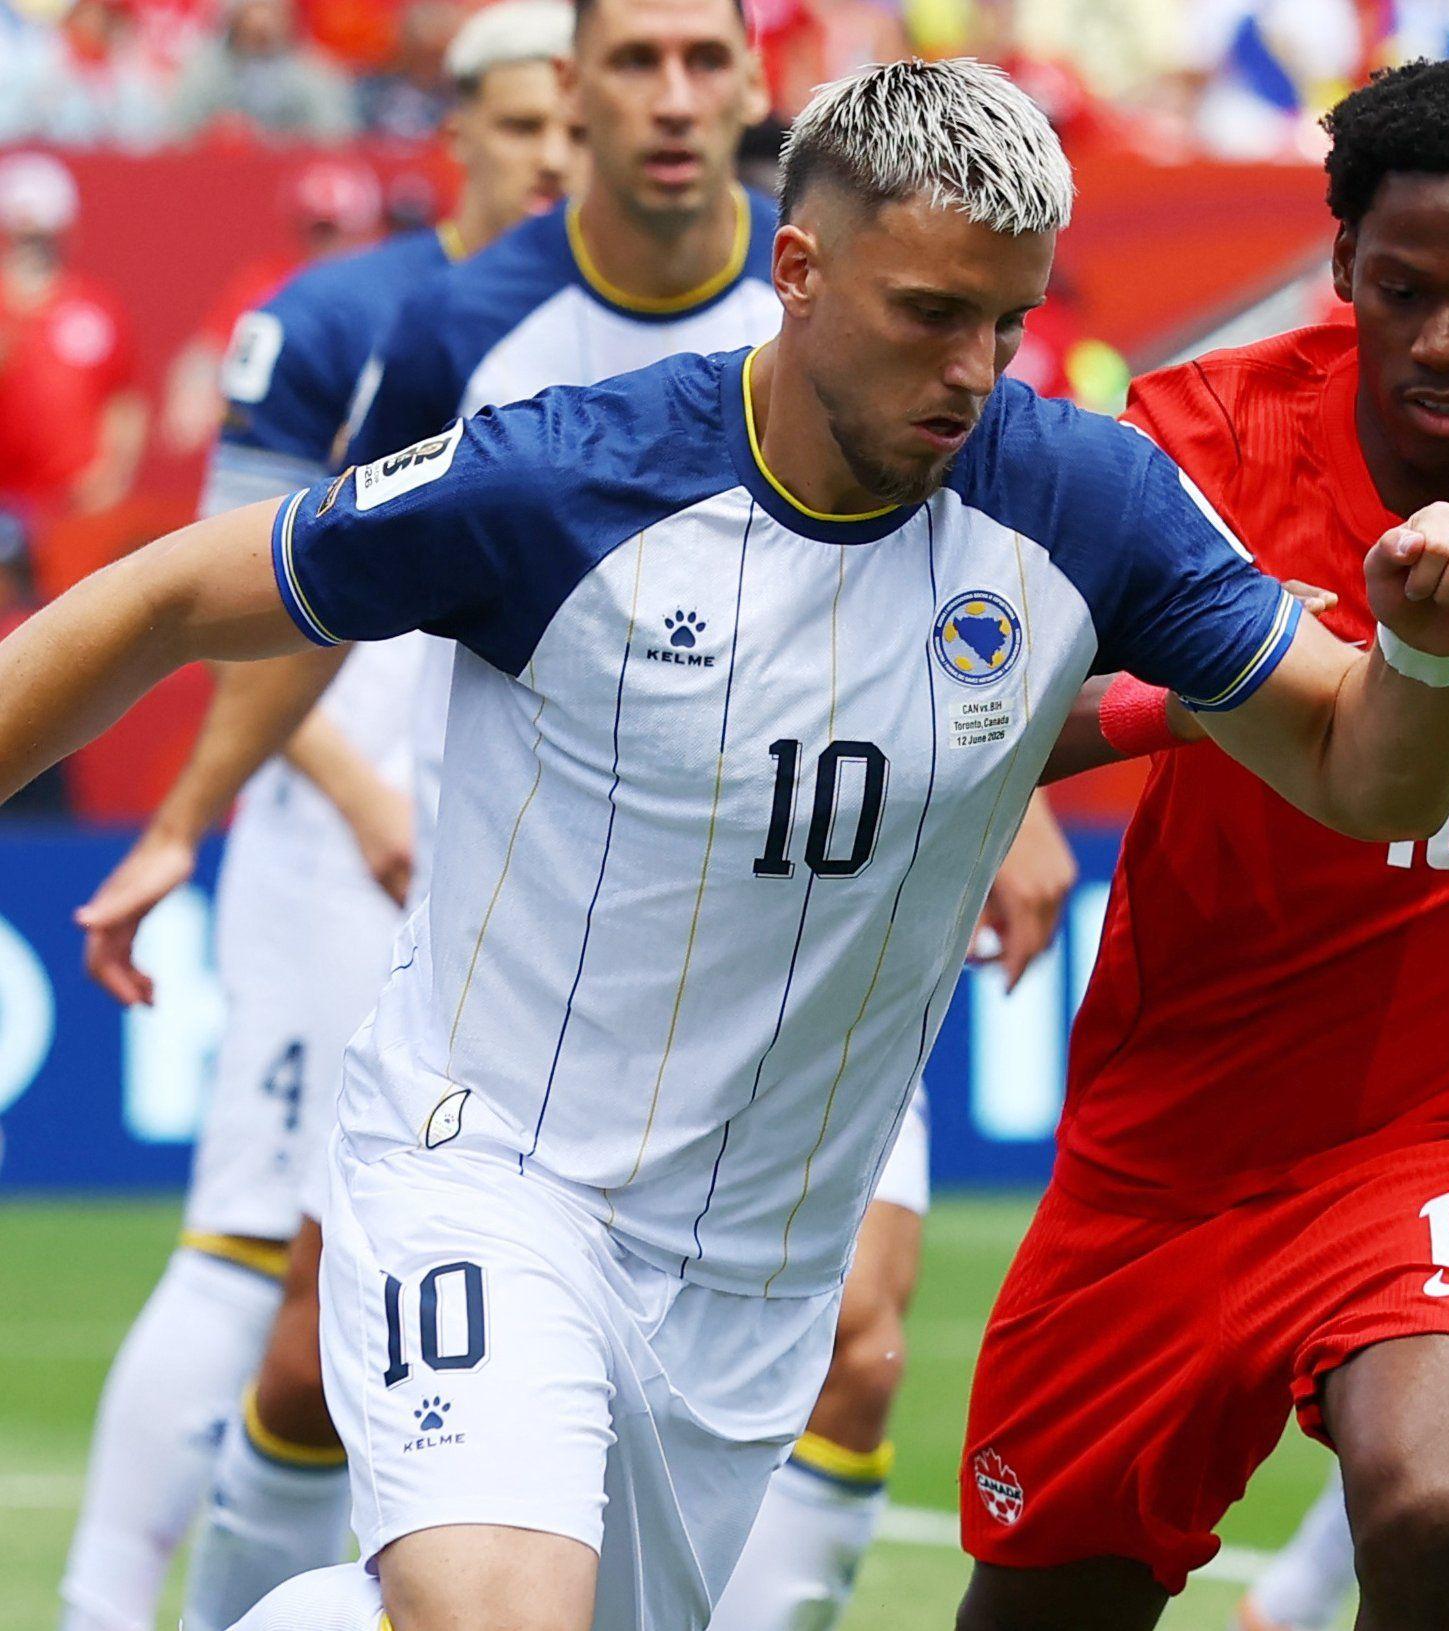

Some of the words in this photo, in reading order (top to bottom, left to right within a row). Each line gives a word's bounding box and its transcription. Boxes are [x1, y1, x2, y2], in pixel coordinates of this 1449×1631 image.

[647, 649, 715, 667] KELME
[962, 703, 979, 714] CAN
[954, 719, 984, 731] Toronto,
[984, 715, 1009, 727] Canada
[957, 736, 967, 746] 12
[968, 735, 987, 745] June
[753, 739, 891, 879] 10
[260, 1037, 306, 1131] 4
[380, 1261, 490, 1390] 10
[403, 1433, 466, 1453] KELME
[977, 1474, 1021, 1500] CANADA
